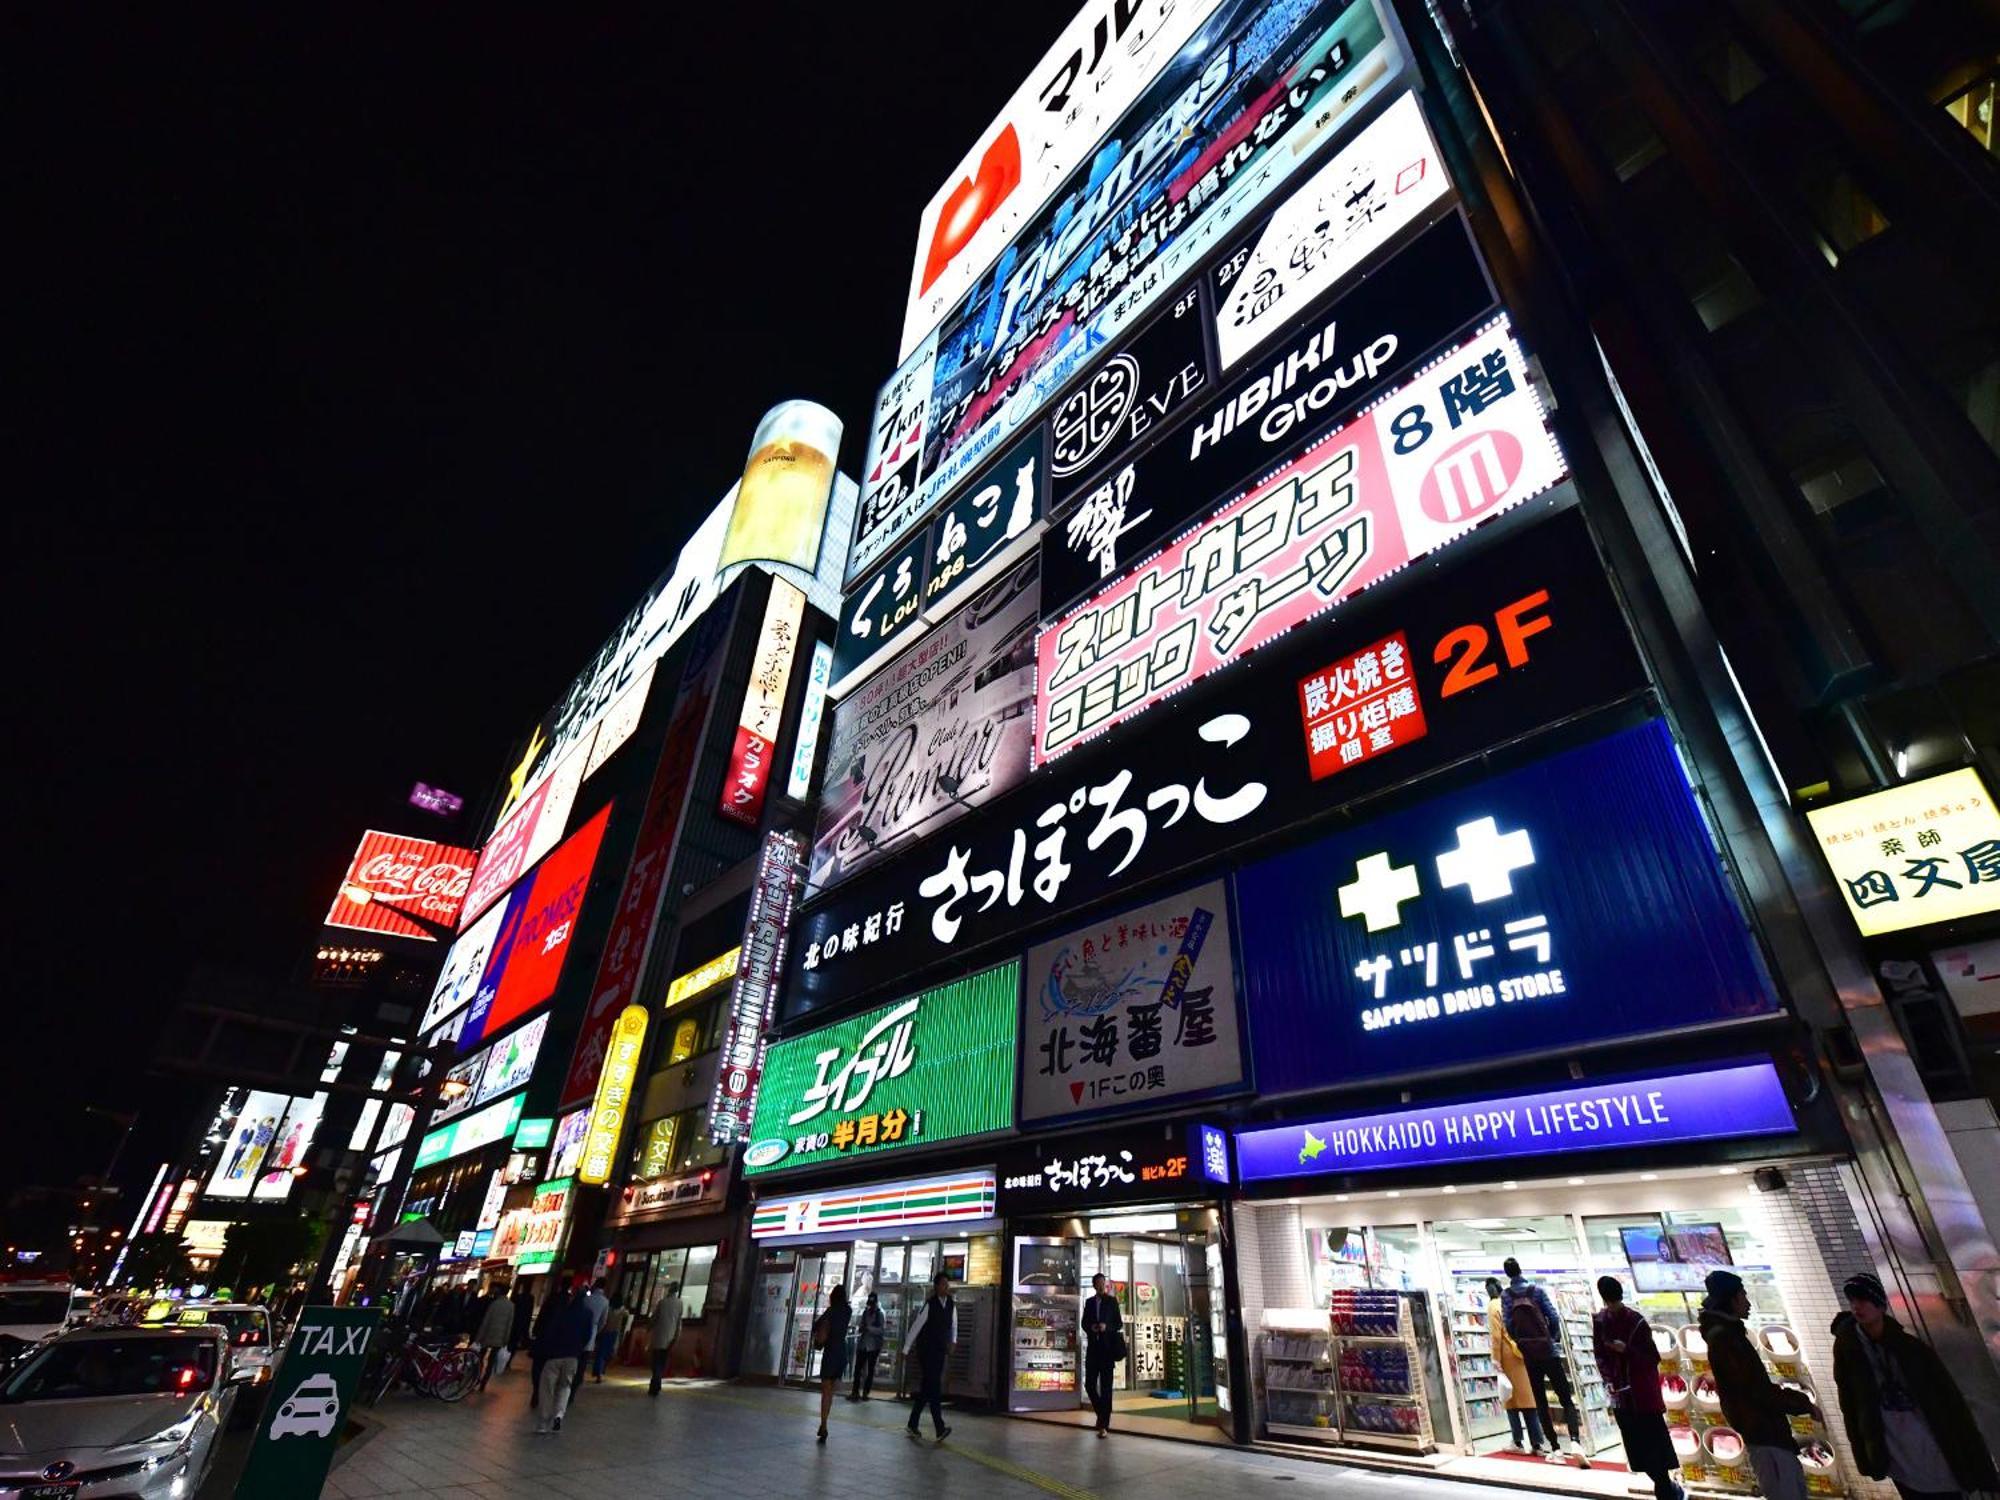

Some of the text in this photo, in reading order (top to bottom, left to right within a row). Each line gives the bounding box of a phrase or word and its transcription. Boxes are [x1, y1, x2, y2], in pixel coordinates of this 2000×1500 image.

[1113, 272, 1158, 323] または
[1218, 247, 1250, 287] 2F
[941, 199, 1169, 434] ファイターズを見ずに
[1174, 288, 1199, 319] 8F
[1130, 361, 1205, 440] EVE
[1189, 322, 1338, 461] HIBIKI
[1259, 332, 1399, 443] Group
[1388, 347, 1519, 457] 8階
[1047, 449, 1355, 692] ネットカフェ
[1207, 516, 1368, 655] ダーツ
[1432, 588, 1554, 699] 2F
[1044, 617, 1198, 754] コミック
[1303, 640, 1406, 719] 炭火焼き
[734, 735, 766, 805] カラオケ
[1338, 726, 1395, 765] 個室
[919, 713, 1268, 944] さっぽろっこ
[1880, 828, 1943, 857] 薬師
[358, 852, 474, 898] Coca-Cola
[802, 901, 906, 972] 北の味紀行
[1052, 916, 1190, 984] い魚と美味い酒
[1354, 914, 1552, 1000] サツドラ
[1039, 985, 1217, 1077] 北海番屋
[1361, 969, 1566, 1032] SAPPORO DRUG STORE
[1089, 1064, 1166, 1100] 1Fこの奥
[1332, 1091, 1670, 1157] HOKKAIDO HAPPY LIFESTYLE
[1043, 1150, 1136, 1193] さっぽろっこ
[299, 1325, 373, 1356] TAXI
